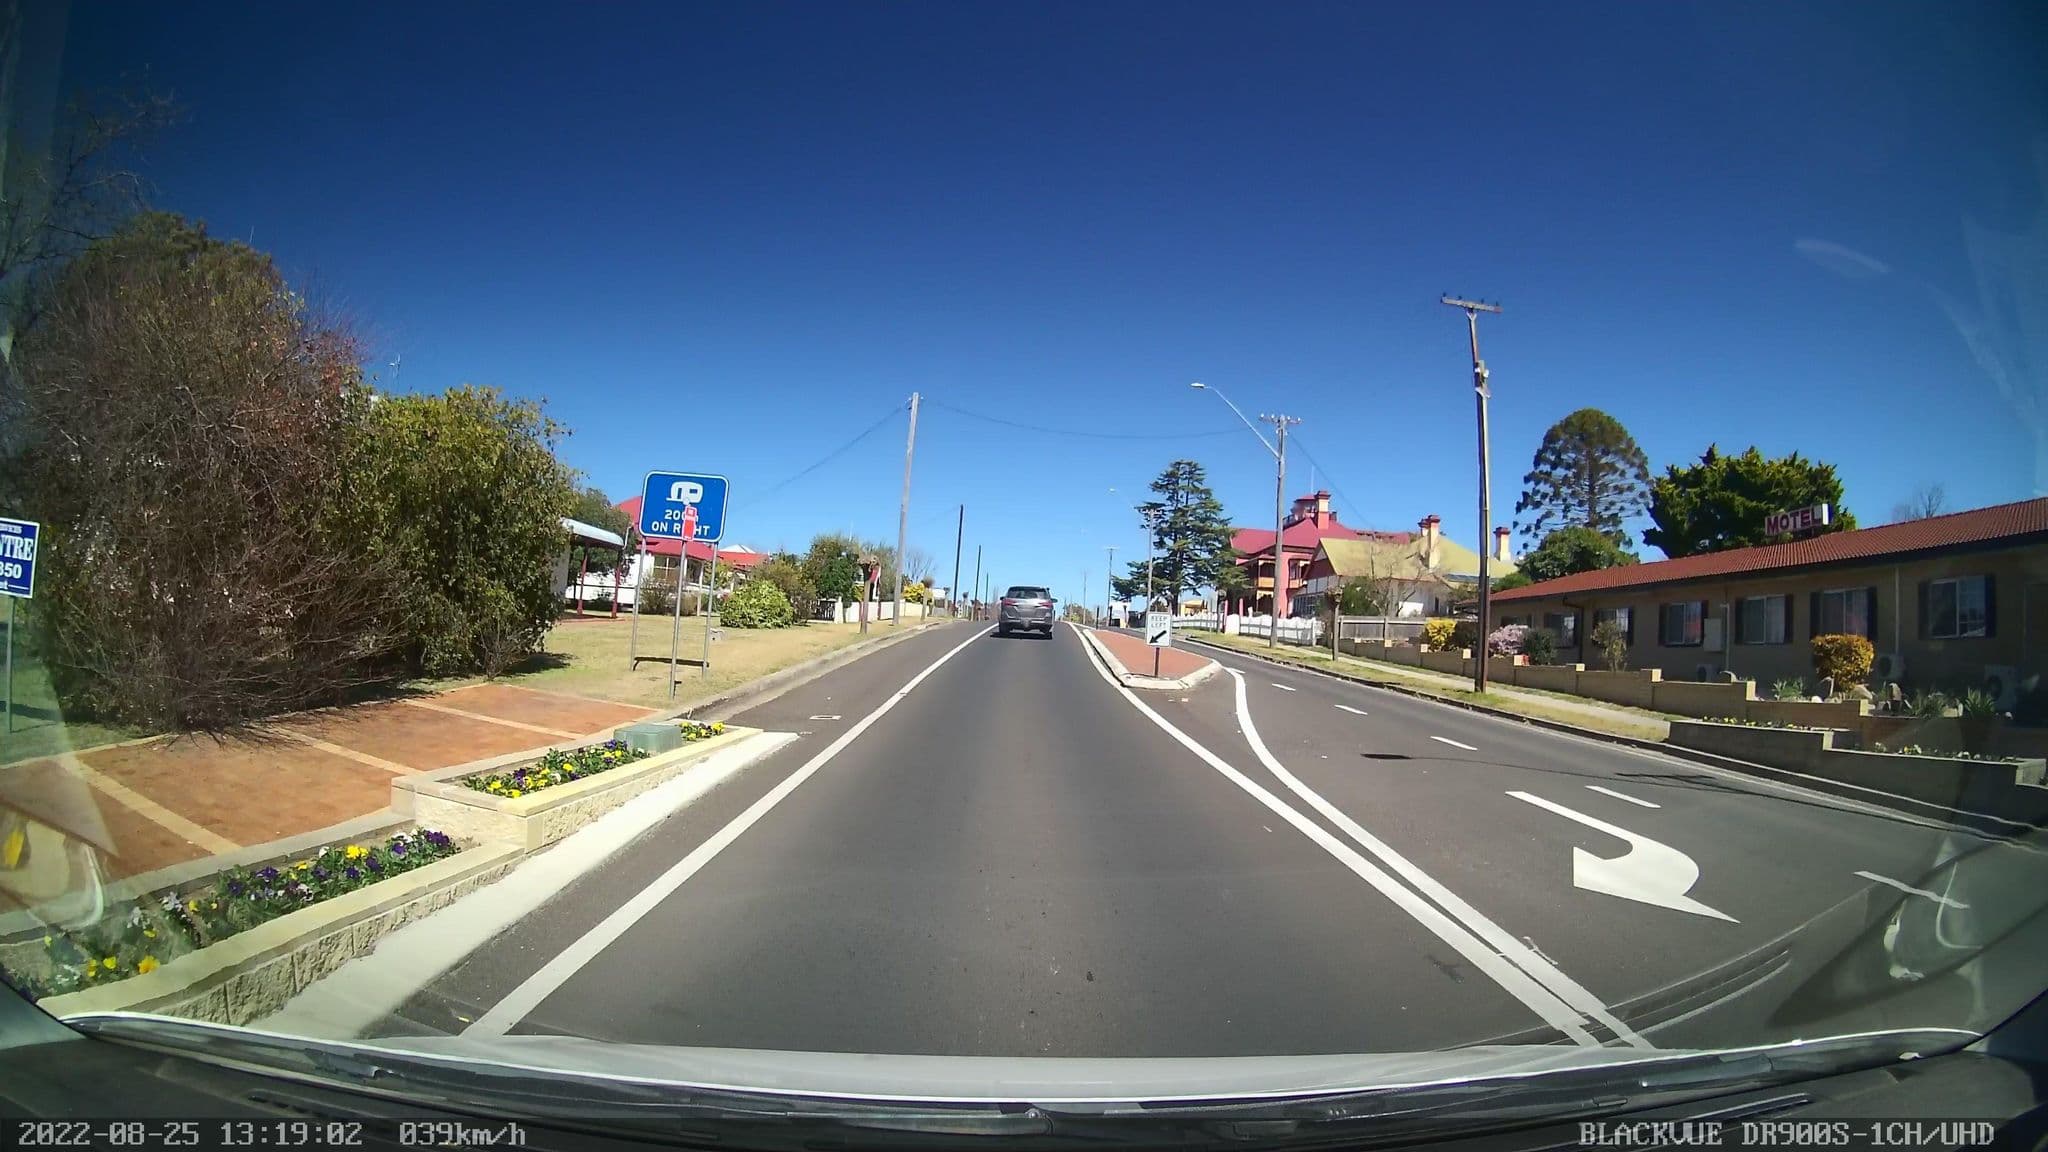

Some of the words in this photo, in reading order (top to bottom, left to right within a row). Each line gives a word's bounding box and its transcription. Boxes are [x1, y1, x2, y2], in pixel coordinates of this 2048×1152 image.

[651, 521, 668, 532] ON
[673, 522, 711, 536] RHT
[1766, 505, 1821, 535] MOTEL
